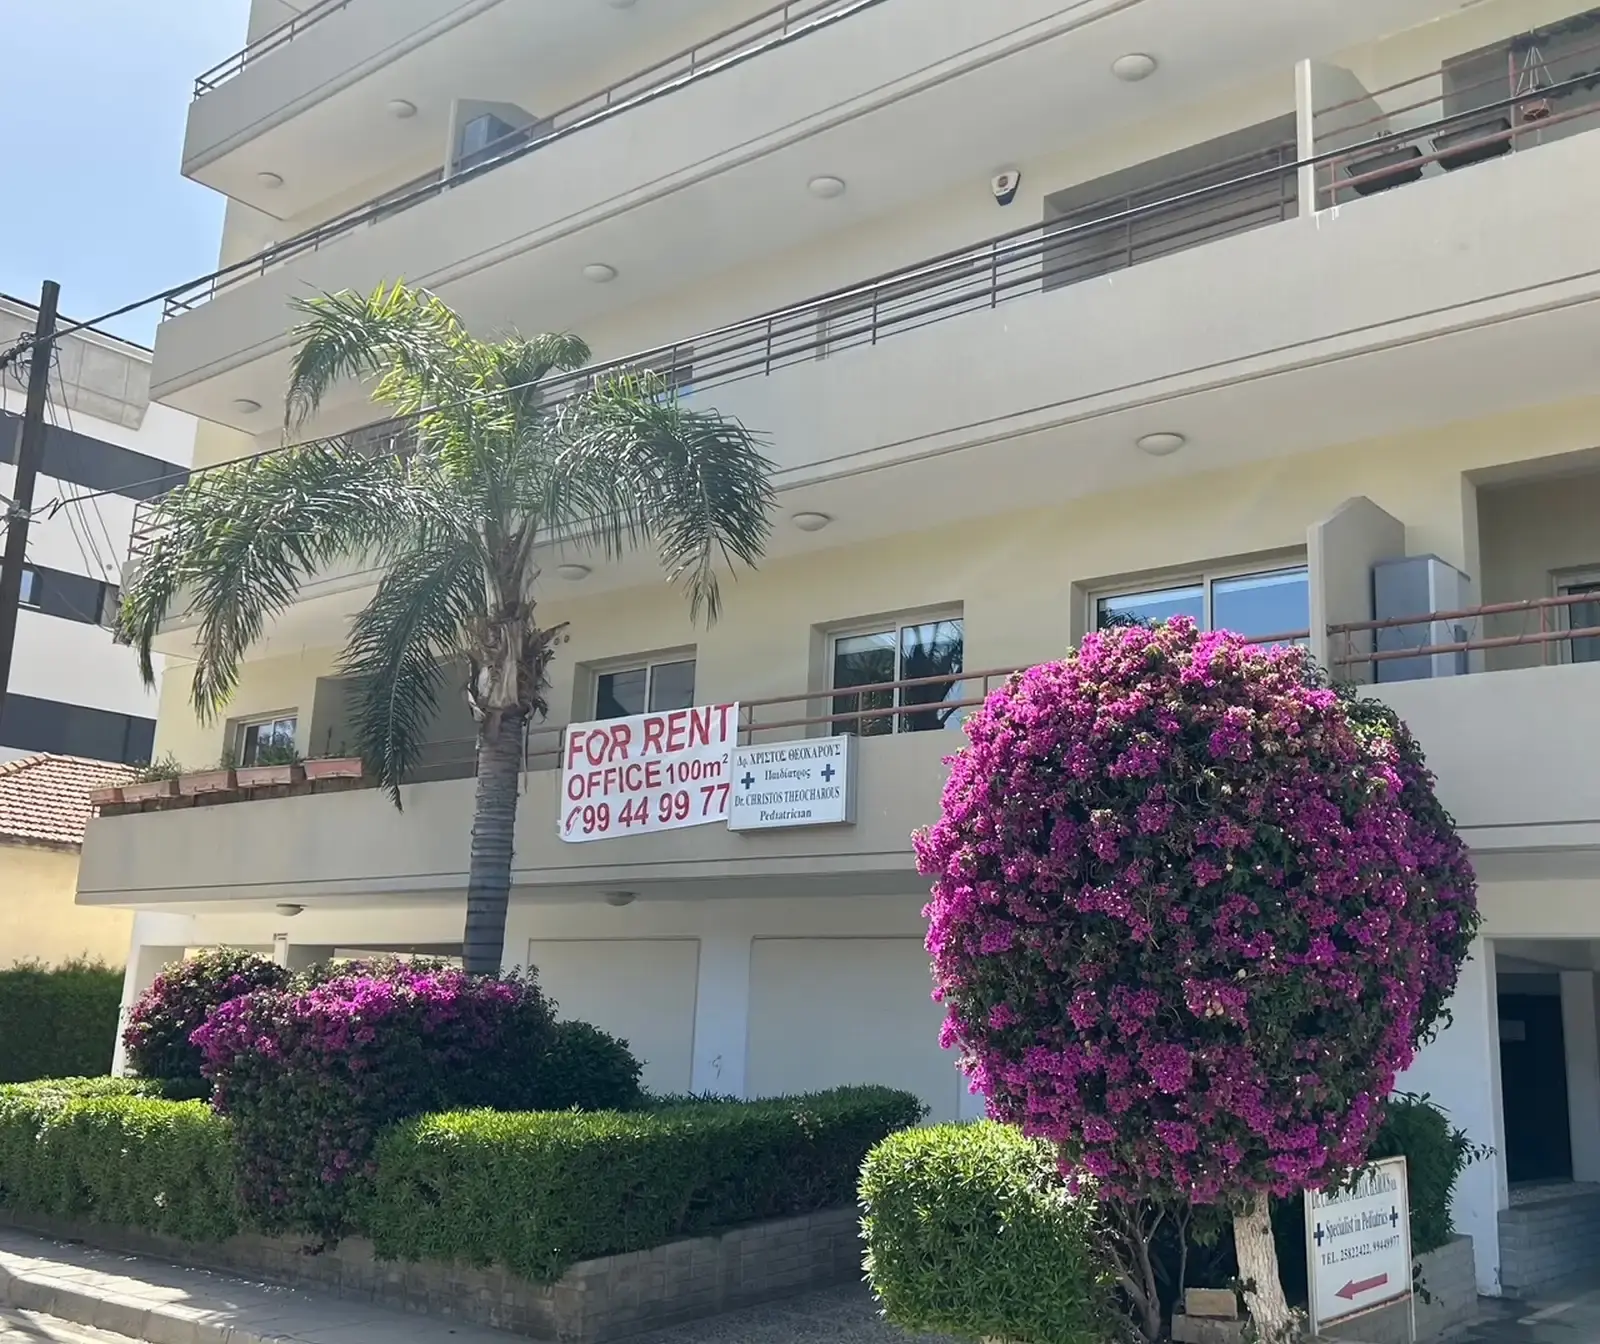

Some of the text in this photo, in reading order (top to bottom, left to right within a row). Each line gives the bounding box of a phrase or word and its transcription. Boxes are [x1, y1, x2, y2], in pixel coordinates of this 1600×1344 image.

[568, 704, 735, 769] FOR RENT
[750, 749, 787, 766] ΧΡΙΣΤΟΣ
[788, 744, 841, 761] ΘΕΟΧΑΡΟΥΣ
[568, 760, 662, 800] OFFICE
[765, 768, 812, 781] Παιδίατρος
[583, 783, 730, 834] 99 44 99 77
[745, 791, 783, 806] CHRISTOS
[784, 786, 840, 803] THEOCHAROUS
[760, 808, 812, 821] Pediatrician
[1325, 1216, 1354, 1244] Specialist
[1354, 1213, 1361, 1232] in
